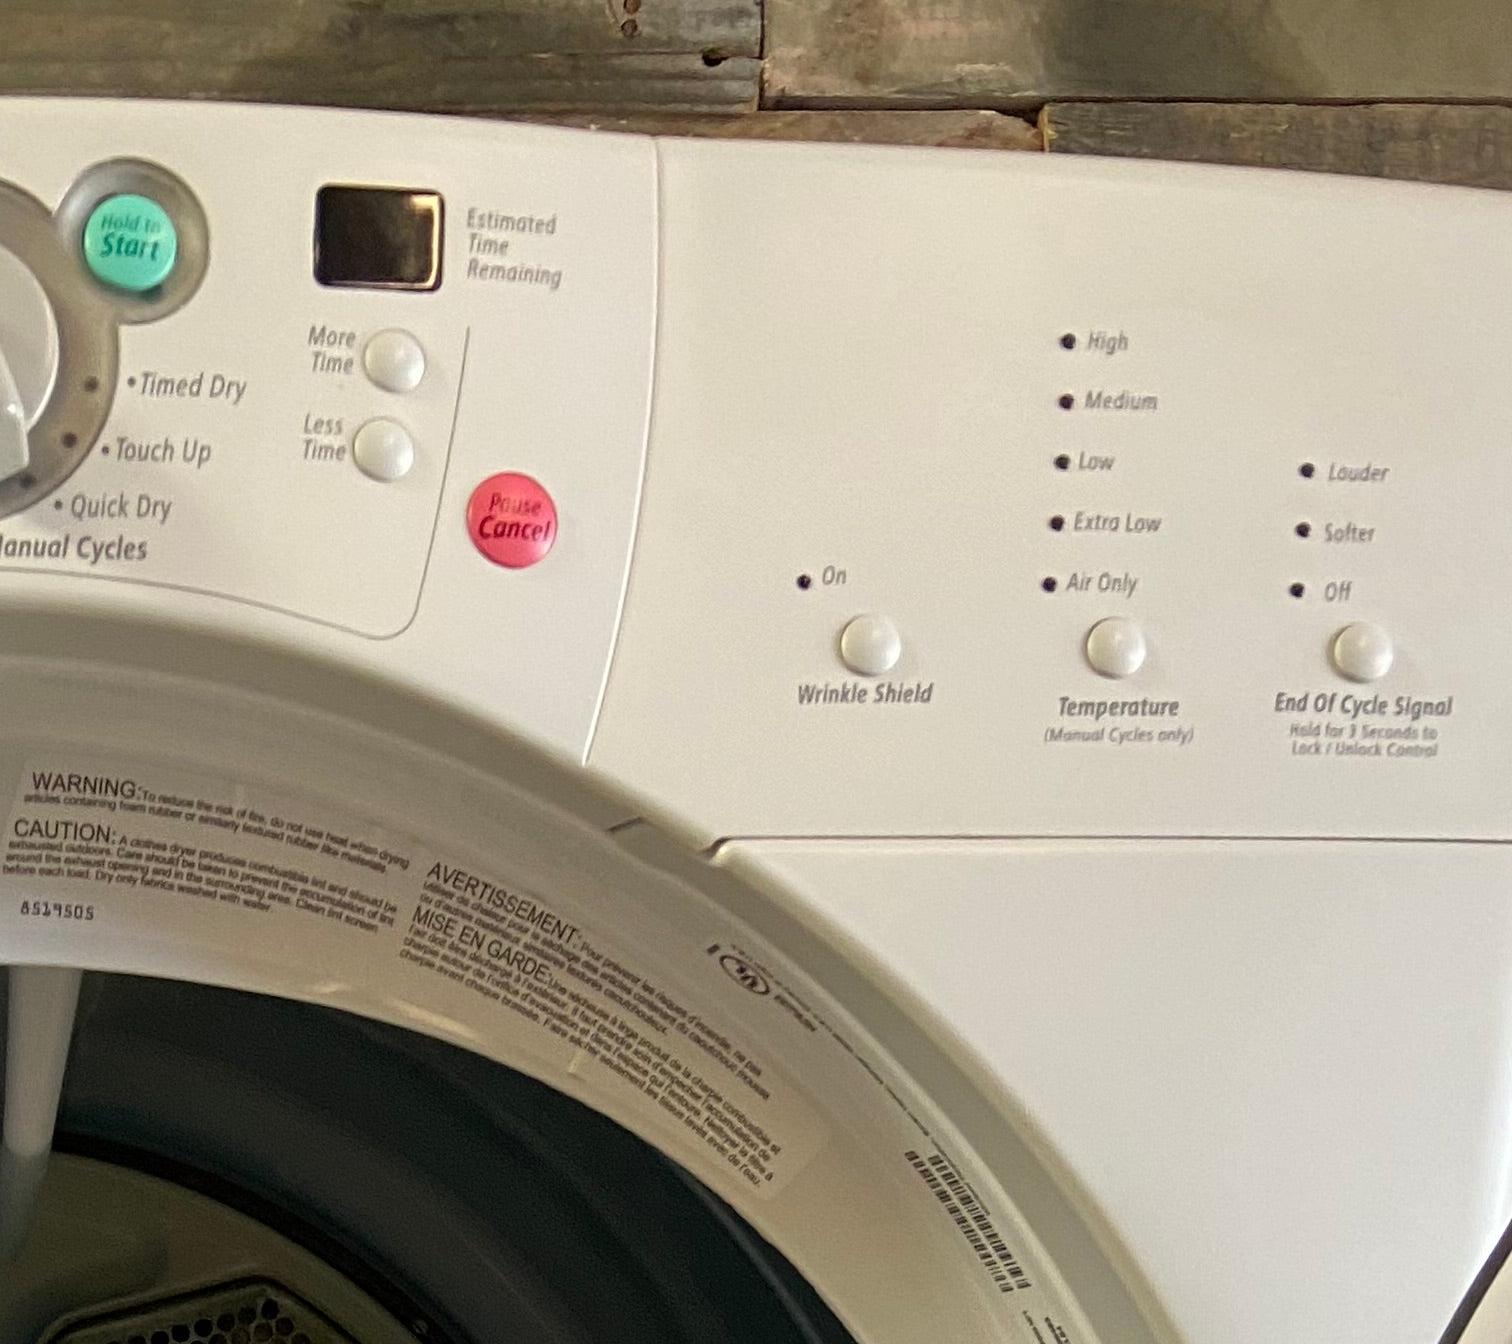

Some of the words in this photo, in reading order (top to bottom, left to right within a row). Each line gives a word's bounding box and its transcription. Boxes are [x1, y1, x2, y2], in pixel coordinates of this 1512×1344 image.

[467, 208, 556, 235] Estimated
[100, 232, 159, 261] Start
[468, 235, 508, 256] Time
[467, 260, 562, 291] Remaining
[308, 325, 355, 347] More
[1087, 331, 1128, 355] High
[312, 352, 353, 375] Time
[141, 371, 203, 399] Timed
[209, 374, 247, 406] Dry
[1085, 390, 1158, 411] Medium
[304, 413, 343, 435] Less
[116, 437, 174, 462] Touch
[182, 439, 211, 468] Up
[304, 438, 346, 461] Time
[1079, 452, 1114, 471] Low
[1328, 463, 1390, 482] Louder
[71, 494, 127, 519] Quick
[136, 496, 172, 522] Dry
[478, 515, 550, 542] Cancel
[1074, 512, 1120, 532] Extra
[1126, 513, 1161, 533] Low
[1324, 522, 1375, 543] Softer
[76, 534, 147, 564] Cycles
[822, 566, 847, 586] On
[1066, 573, 1092, 592] Air
[1098, 573, 1137, 598] Only
[1325, 581, 1352, 601] Off
[798, 683, 868, 705] Wrinkle
[873, 683, 934, 705] Shield
[1059, 697, 1179, 720] Temperature
[1275, 692, 1310, 713] End
[1314, 693, 1336, 713] Of
[1340, 695, 1387, 719] Cycle
[1393, 696, 1452, 721] Signal
[1044, 727, 1104, 744] (Manual
[1109, 727, 1153, 744] Cycles
[1158, 727, 1194, 746] only)
[14, 818, 116, 845] CAUTION:
[21, 900, 94, 920] 8519505
[412, 907, 457, 936] MISE
[457, 926, 487, 951] EN
